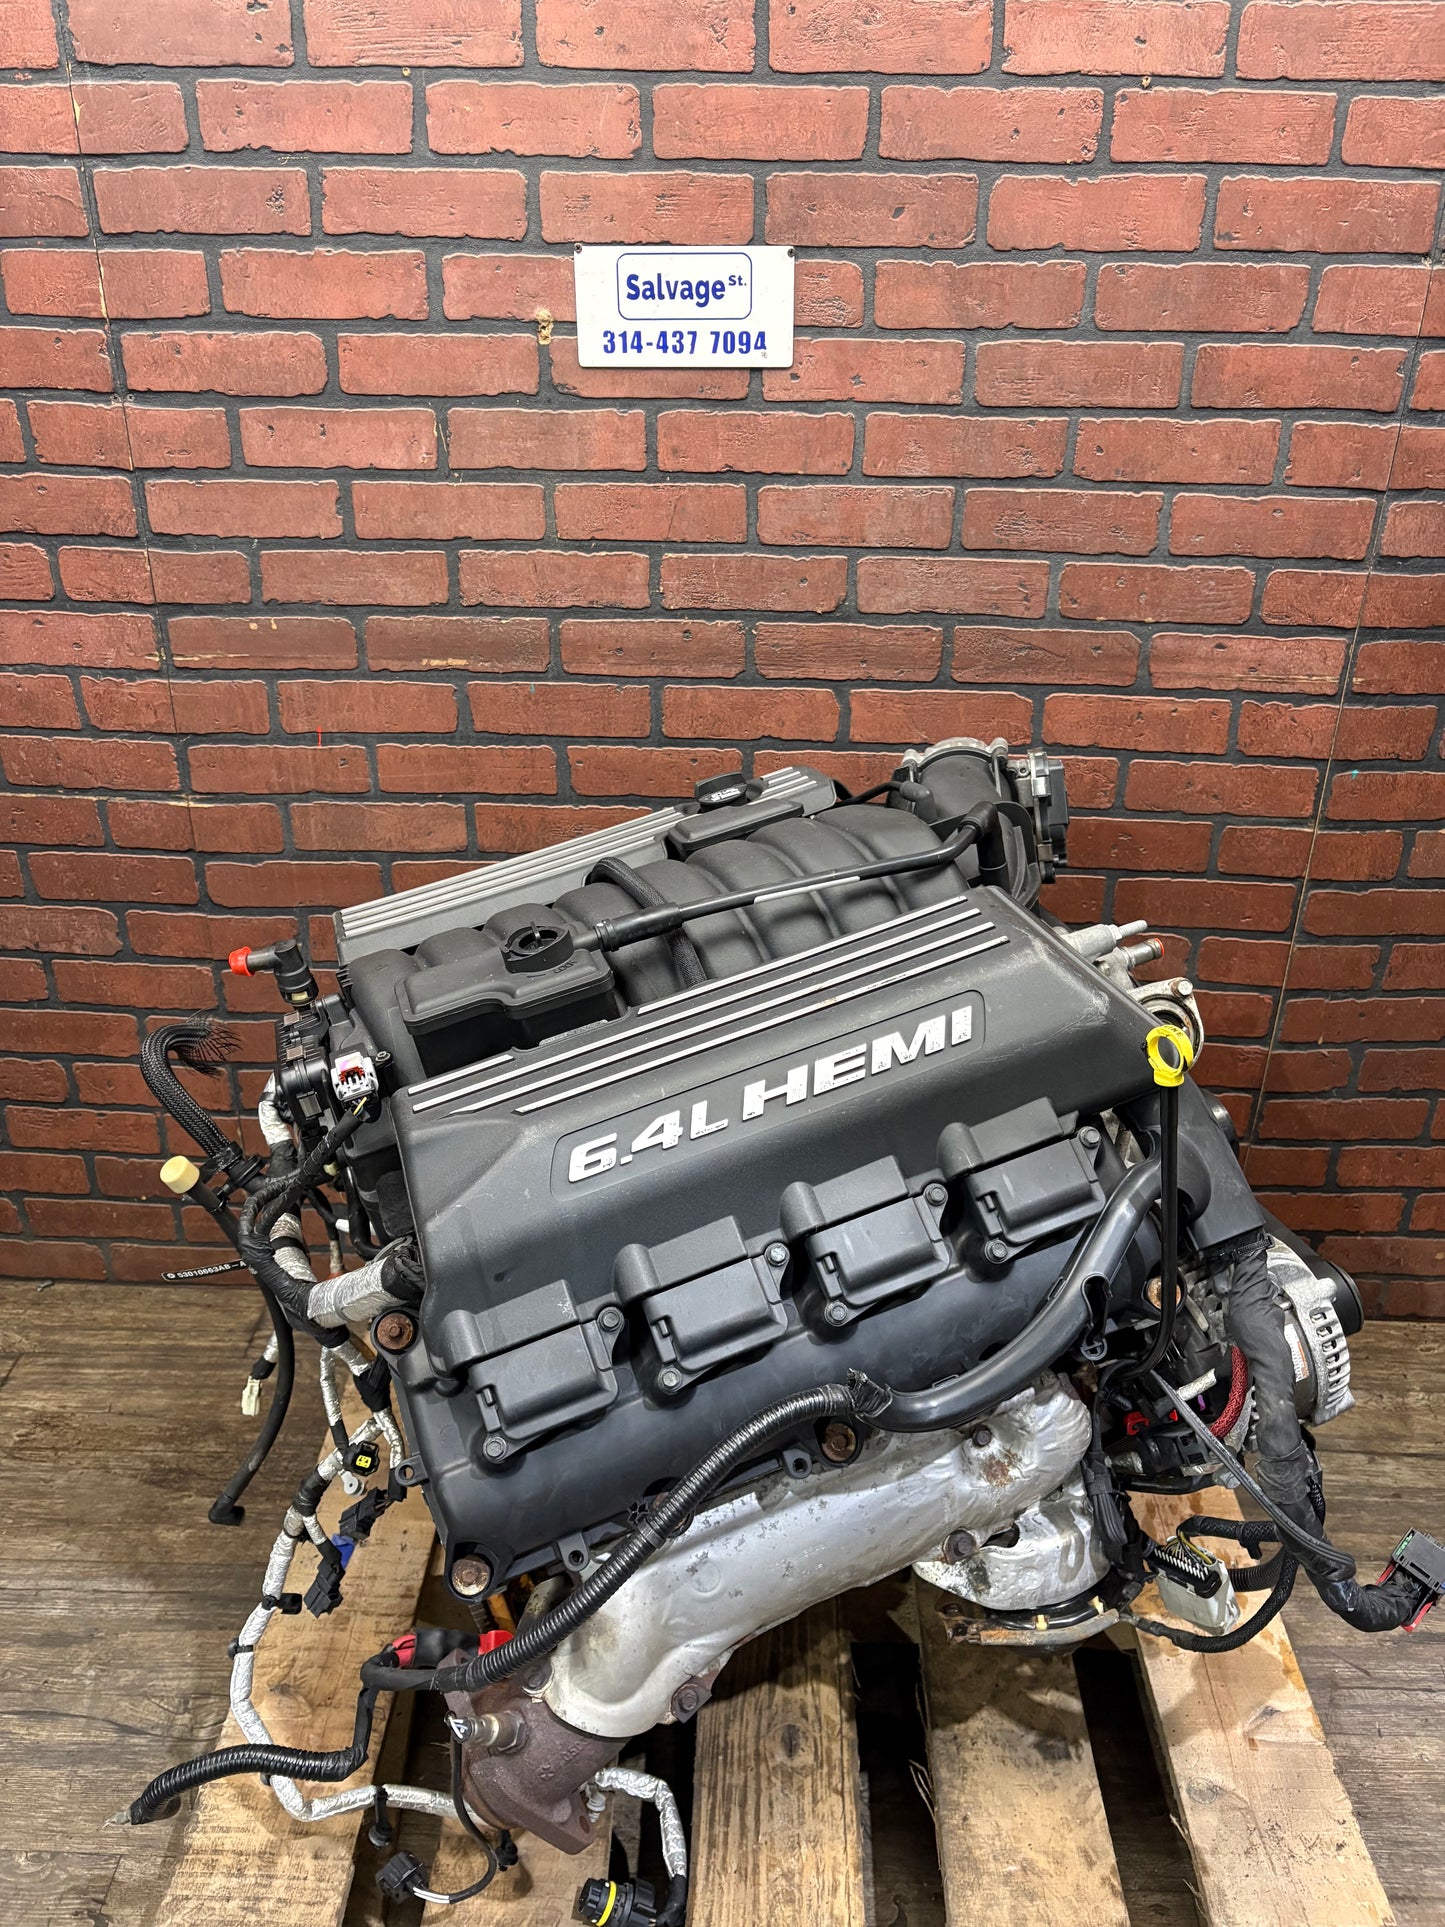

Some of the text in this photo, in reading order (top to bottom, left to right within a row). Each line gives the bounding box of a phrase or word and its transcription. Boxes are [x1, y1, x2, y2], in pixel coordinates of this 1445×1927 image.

[626, 273, 747, 308] Salvage St.
[603, 330, 767, 354] 314-437 7094
[568, 1005, 972, 1182] 6.4L HEMI
